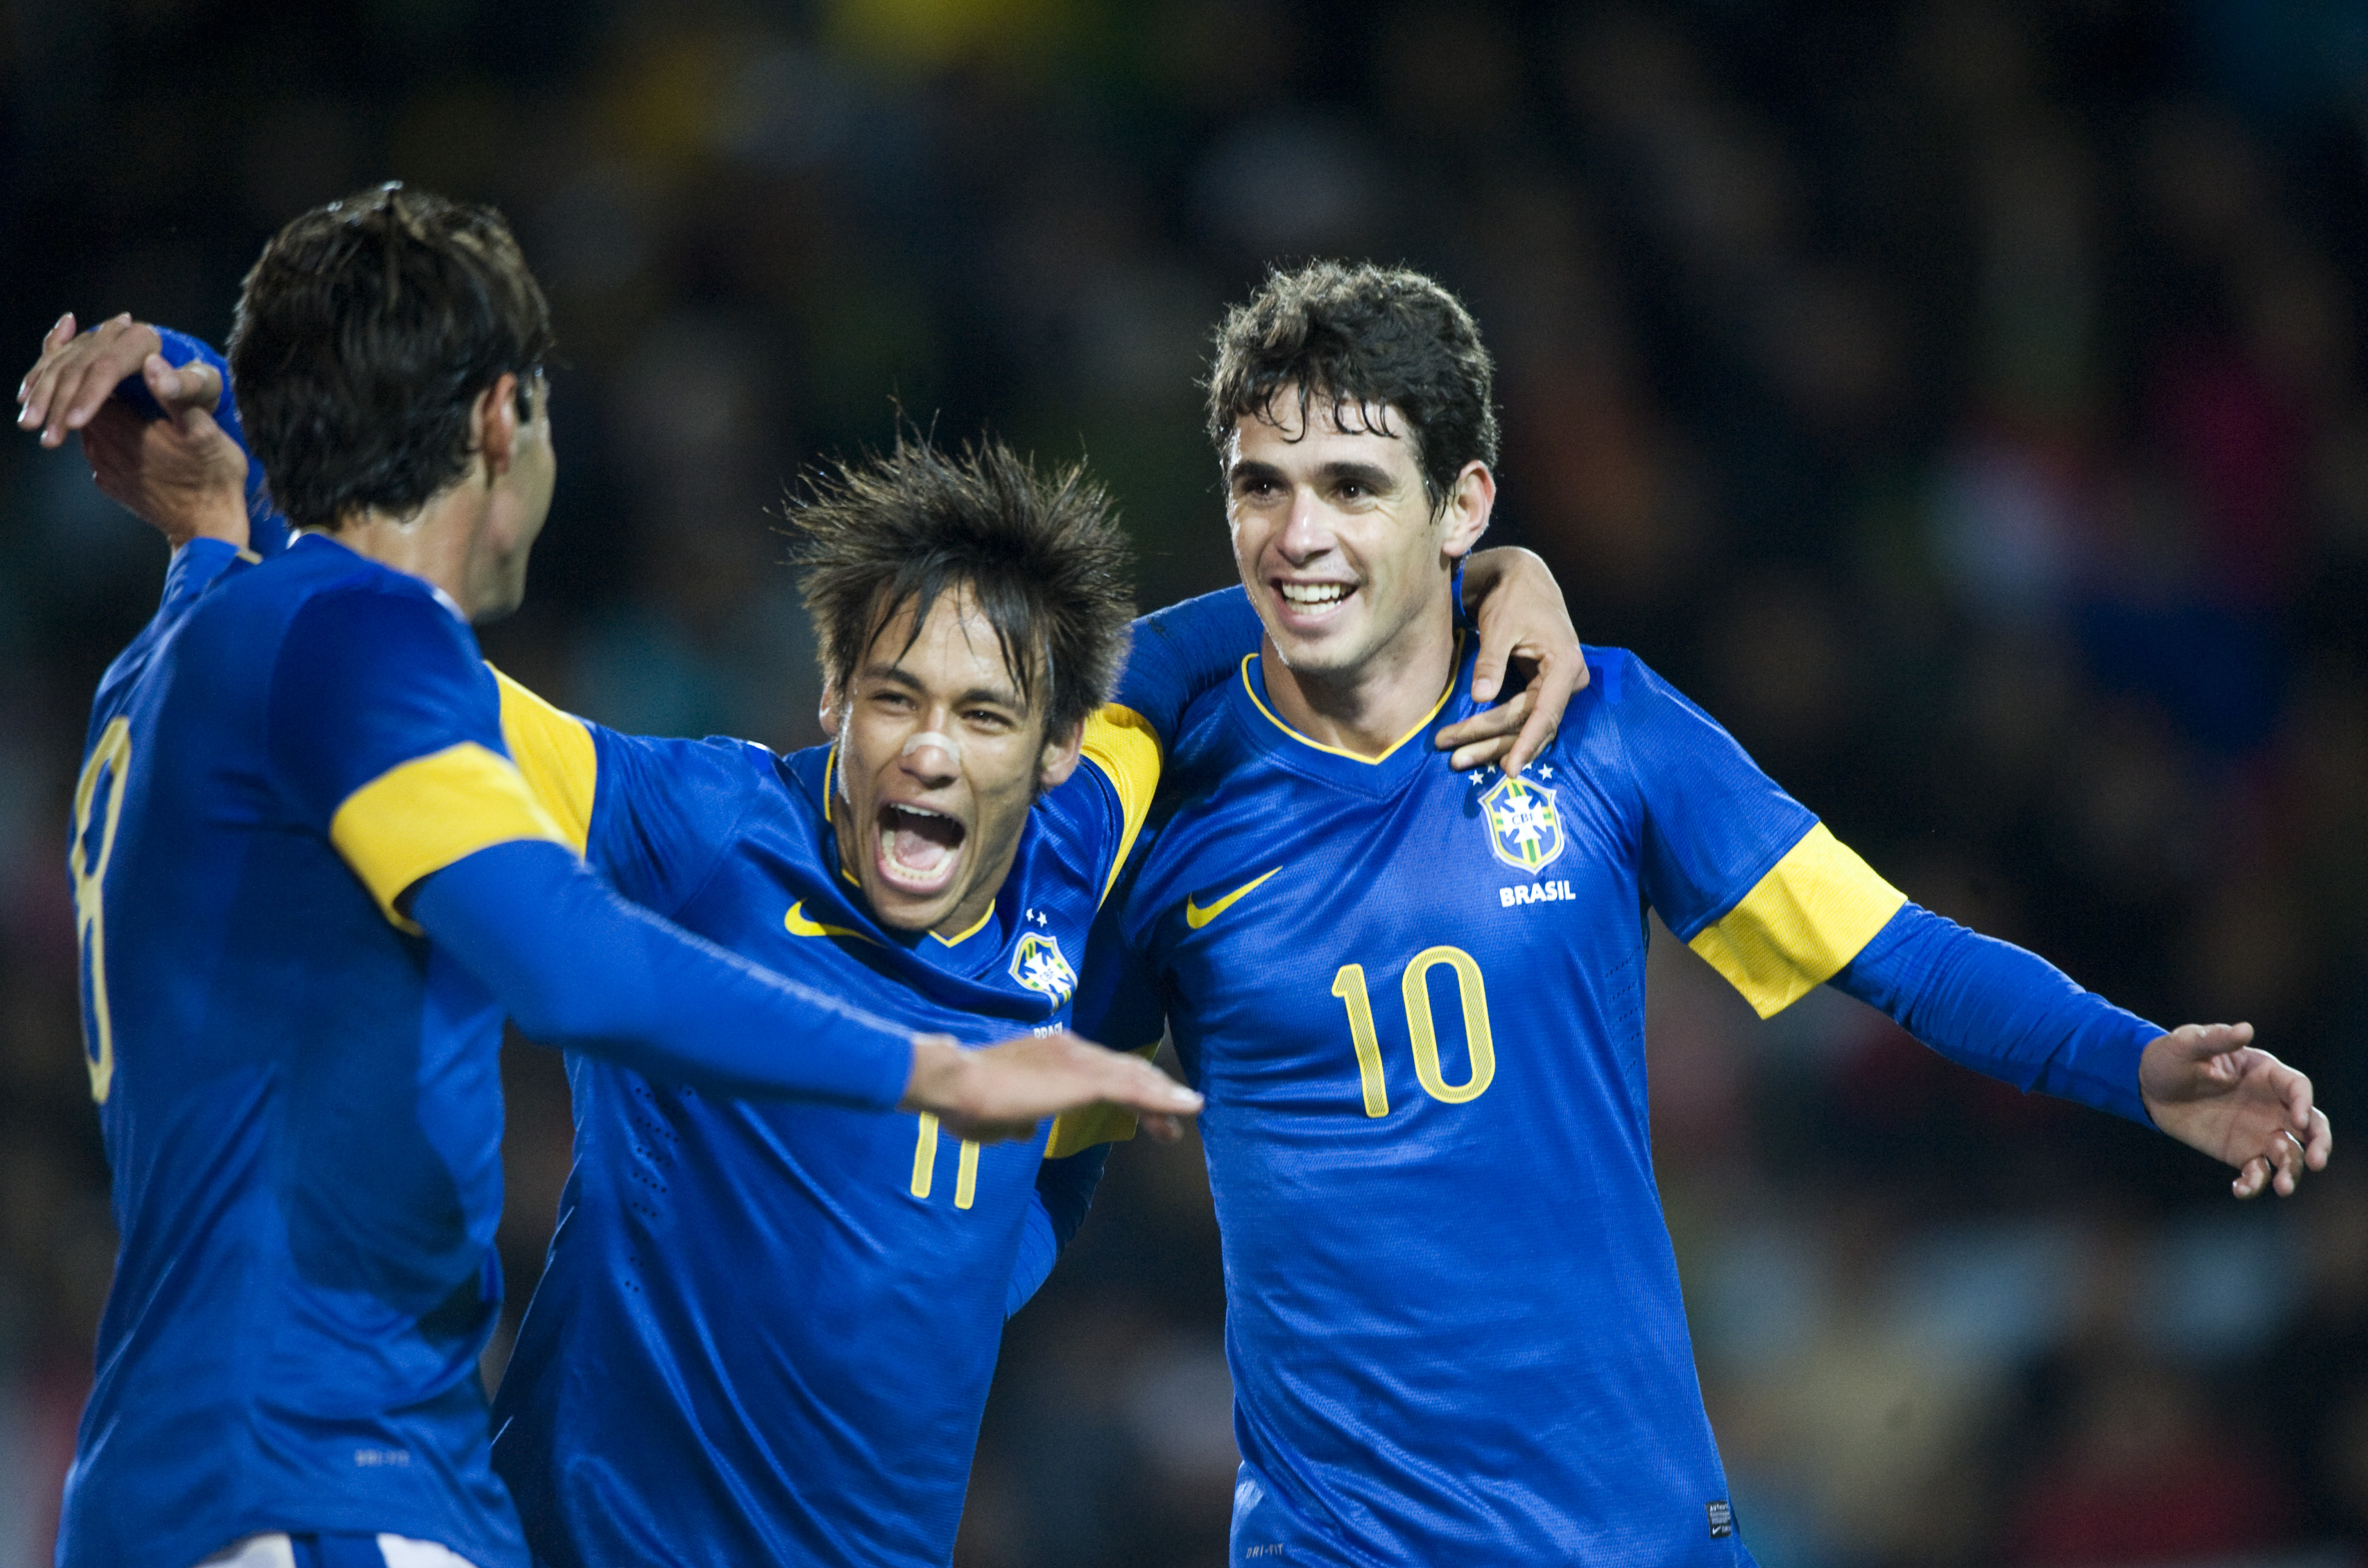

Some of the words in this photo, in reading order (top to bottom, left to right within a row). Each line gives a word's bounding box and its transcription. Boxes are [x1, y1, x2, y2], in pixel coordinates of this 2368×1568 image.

[1499, 880, 1576, 907] BRASIL
[1039, 968, 1055, 982] CBF
[1331, 945, 1495, 1118] 10
[1246, 1543, 1283, 1559] DRI-FIT
